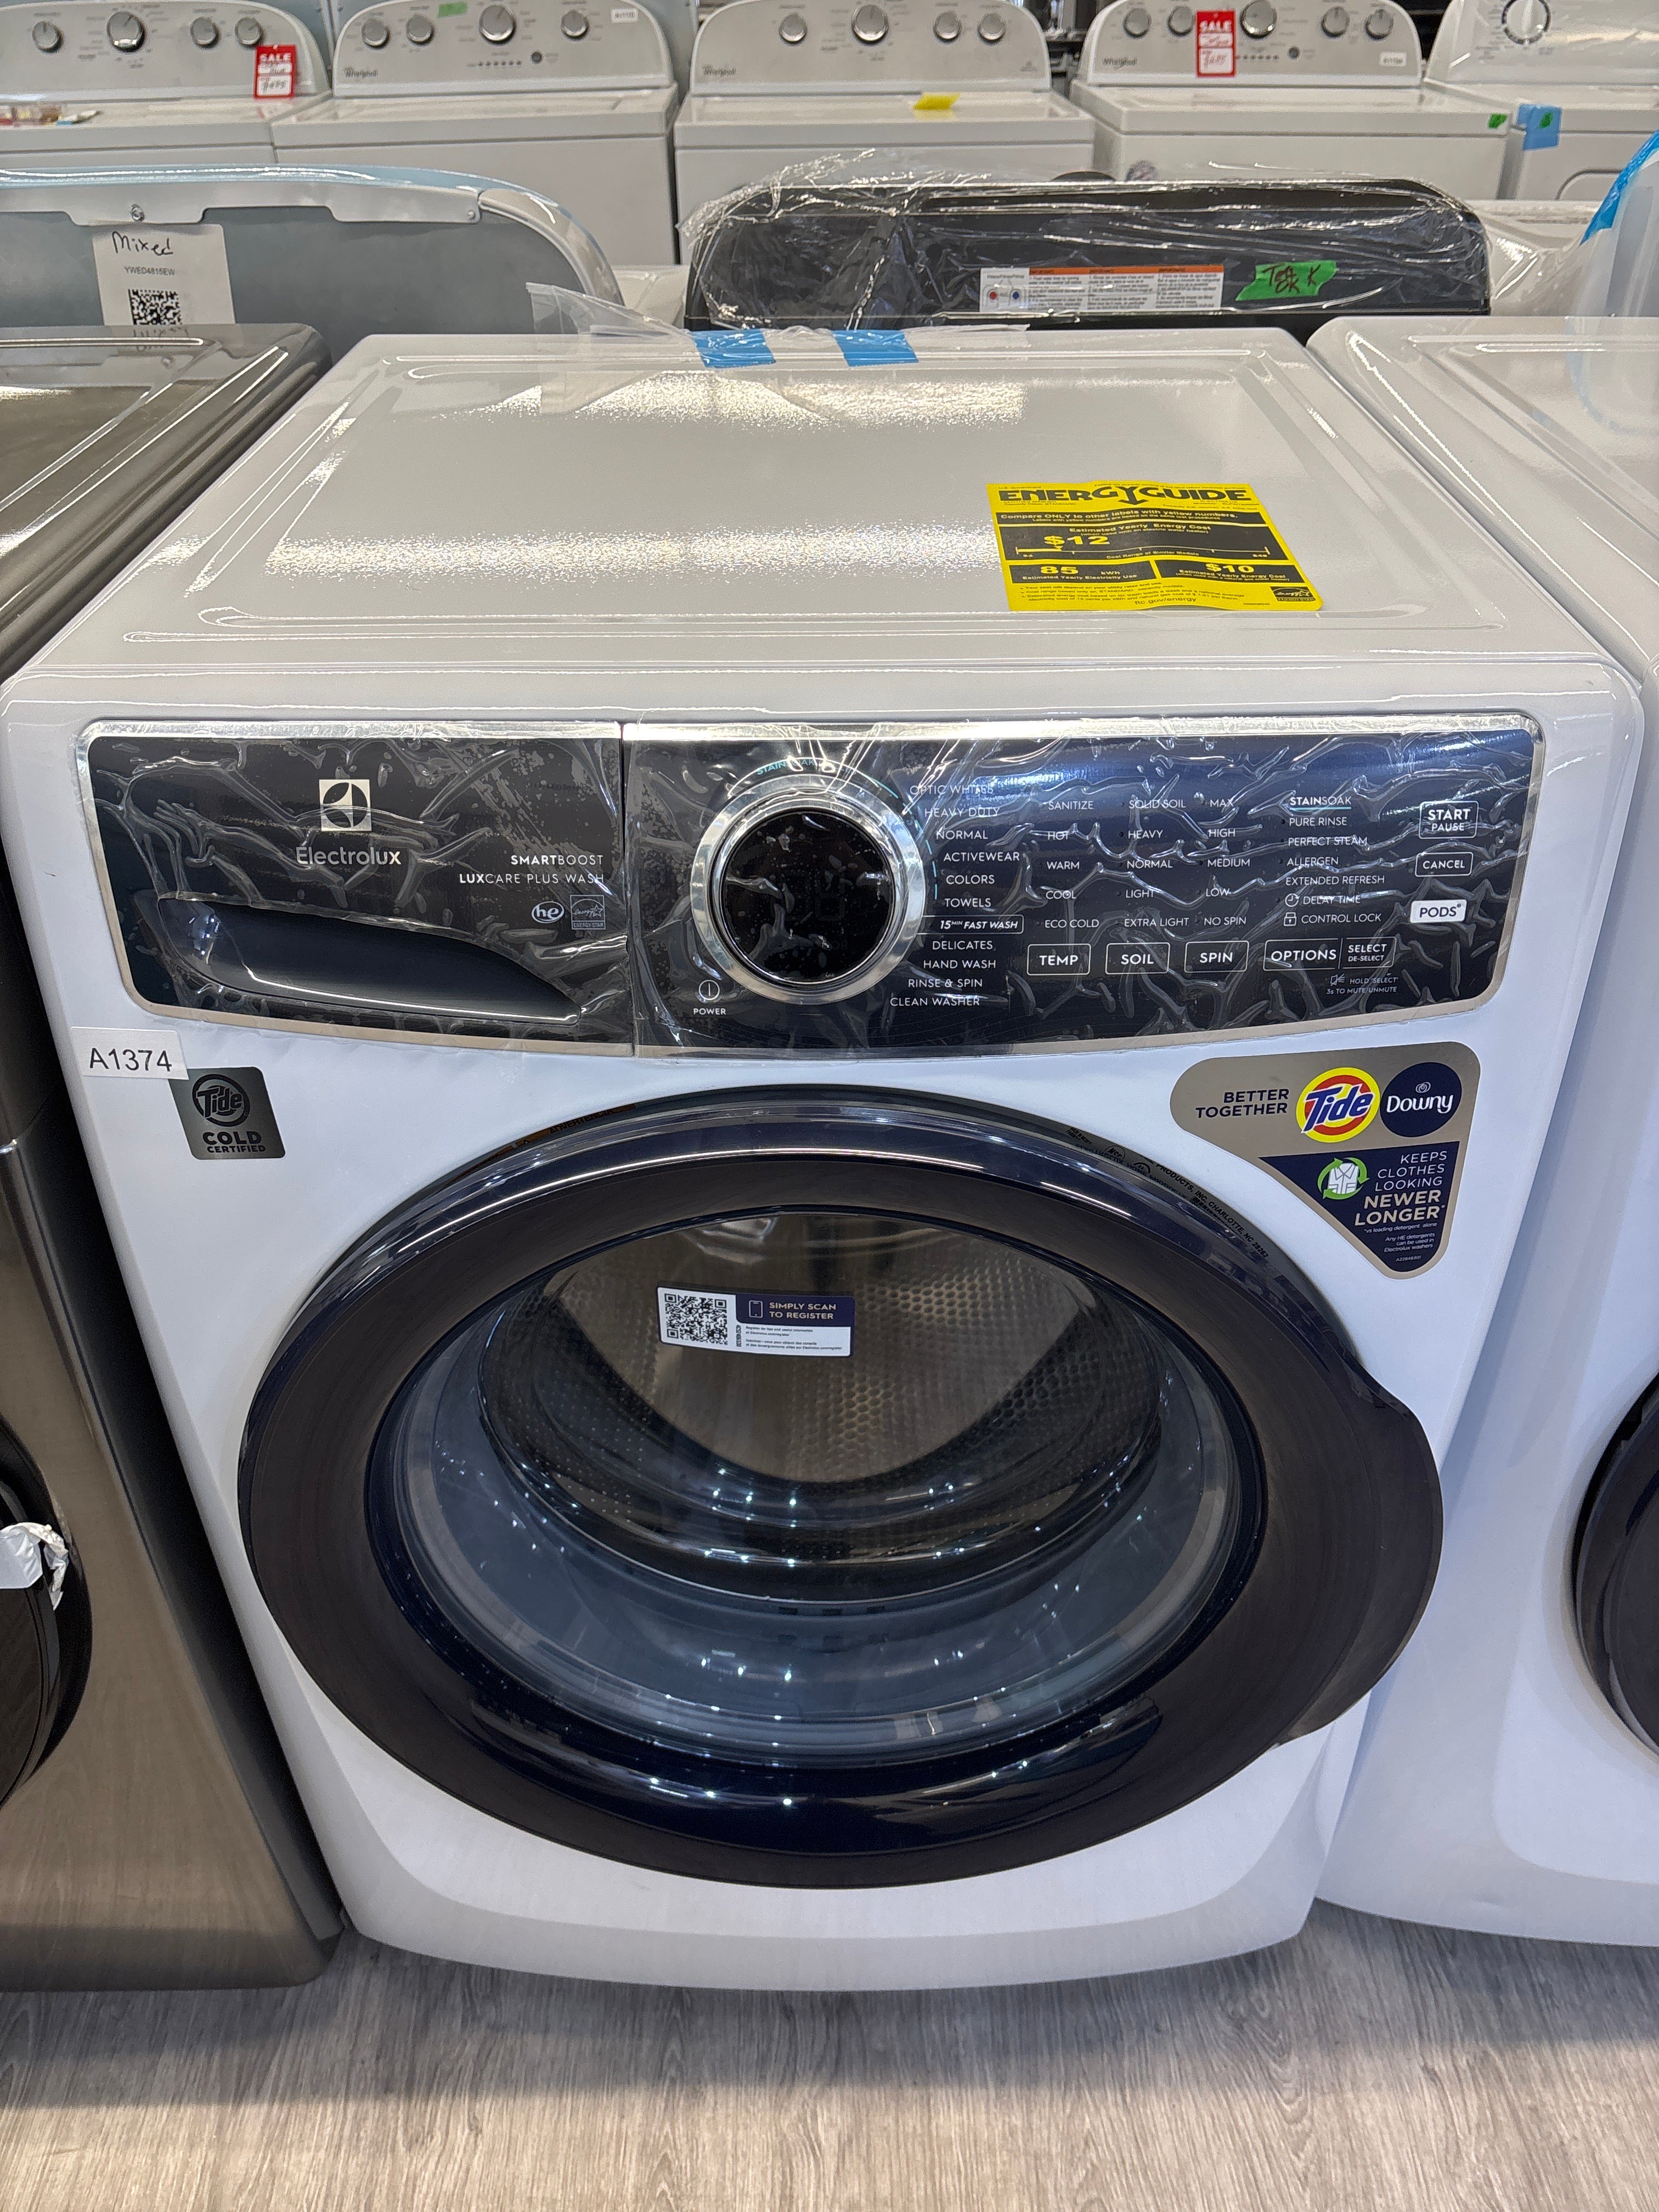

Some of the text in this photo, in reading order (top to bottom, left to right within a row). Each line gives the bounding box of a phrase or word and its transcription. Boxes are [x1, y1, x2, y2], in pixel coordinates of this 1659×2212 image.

[1200, 20, 1232, 32] SALE
[258, 52, 292, 62] SALE
[111, 231, 173, 256] Mixed
[998, 486, 1252, 506] ENERGYGUIDE
[1043, 535, 1110, 545] $12
[1041, 566, 1079, 574] 85
[1205, 563, 1255, 573] $10
[910, 785, 994, 795] OPTIC WHITES
[1048, 800, 1094, 810] SANITIZE
[1129, 799, 1186, 809] SOLID SOIL
[1210, 799, 1234, 807] MAX
[1290, 796, 1352, 805] STAINSOAK
[925, 808, 1000, 817] HEAVY DUTY
[1428, 809, 1470, 820] START
[1289, 817, 1347, 826] PURE RINSE
[1431, 823, 1465, 832] PAUSE
[936, 830, 988, 840] NORMAL
[1048, 831, 1069, 840] HOT
[1128, 830, 1163, 839] HEAVY
[1209, 829, 1235, 837] HIGH
[1288, 837, 1368, 847] PERFECT STEAM
[296, 847, 402, 865] Electrolux
[511, 855, 603, 865] SMARTBOOST
[944, 853, 1020, 862] ACTIVEWEAR
[1047, 861, 1080, 870] WARM
[1127, 860, 1173, 868] NORMAL
[1207, 859, 1250, 867] MEDIUM
[1286, 857, 1339, 866] ALLERGEN
[1423, 860, 1465, 870] CANCEL
[459, 873, 604, 884] LUXCARE PLUS WASH
[946, 875, 995, 885] COLORS
[1285, 876, 1385, 887] EXTENDED REFRESH
[1046, 890, 1077, 900] COOL
[1126, 889, 1155, 898] LIGHT
[1206, 889, 1230, 897] LOW
[945, 898, 991, 907] TOWELS
[1304, 895, 1361, 905] DELAY TIME
[1045, 918, 1099, 928] ECO COLD
[1124, 917, 1189, 927] EXTRA LIGHT
[1204, 916, 1246, 926] NO SPIN
[1301, 913, 1382, 924] CONTROL LOCK
[963, 921, 988, 929] FAST
[933, 941, 993, 950] DELICATES
[1348, 944, 1387, 953] SELECT
[1121, 953, 1154, 965] SOIL
[1199, 952, 1233, 964] SPIN
[1271, 949, 1337, 961] OPTIONS
[923, 960, 996, 969] HAND WASH
[1040, 955, 1079, 966] TEMP
[909, 979, 983, 988] RINSE & SPIN
[890, 997, 980, 1006] CLEAN WASHER
[89, 1047, 172, 1072] A1374
[1223, 1088, 1289, 1103] BETTER
[198, 1086, 242, 1119] Tide
[1386, 1094, 1454, 1114] Downy
[1195, 1103, 1288, 1119] TOGETHER
[1300, 1084, 1375, 1133] Tide
[202, 1131, 262, 1145] COLD
[1400, 1151, 1447, 1164] KEEPS
[1378, 1164, 1444, 1179] CLOTHES
[1375, 1176, 1442, 1192] LOOKING
[1156, 1164, 1194, 1193] PRODUCTS,
[1194, 1190, 1207, 1203] INC.
[1209, 1201, 1244, 1234] CHARLOTTE,
[1244, 1233, 1254, 1243] NC
[1363, 1189, 1442, 1209] NEWER
